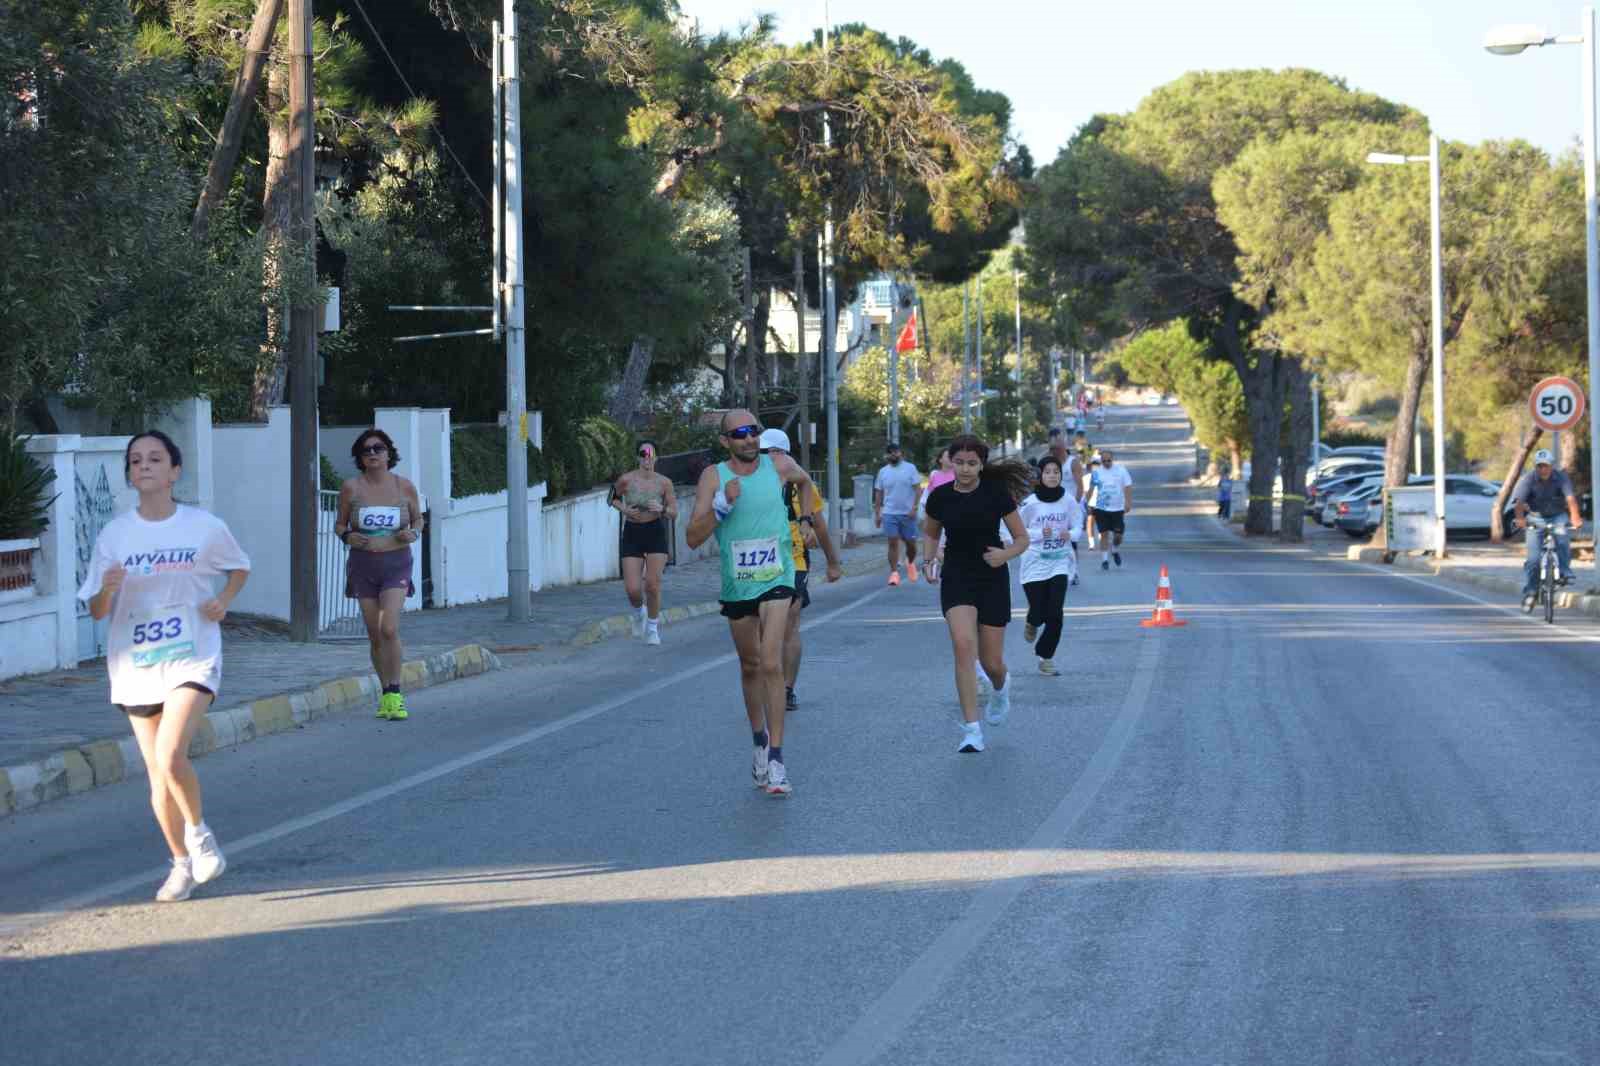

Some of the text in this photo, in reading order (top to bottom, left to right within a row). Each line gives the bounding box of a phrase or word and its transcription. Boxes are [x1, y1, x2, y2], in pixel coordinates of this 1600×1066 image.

[1541, 395, 1573, 416] 50
[363, 514, 394, 527] 631
[124, 552, 196, 567] AYVALIK
[737, 547, 776, 566] 1174
[133, 617, 182, 645] 533
